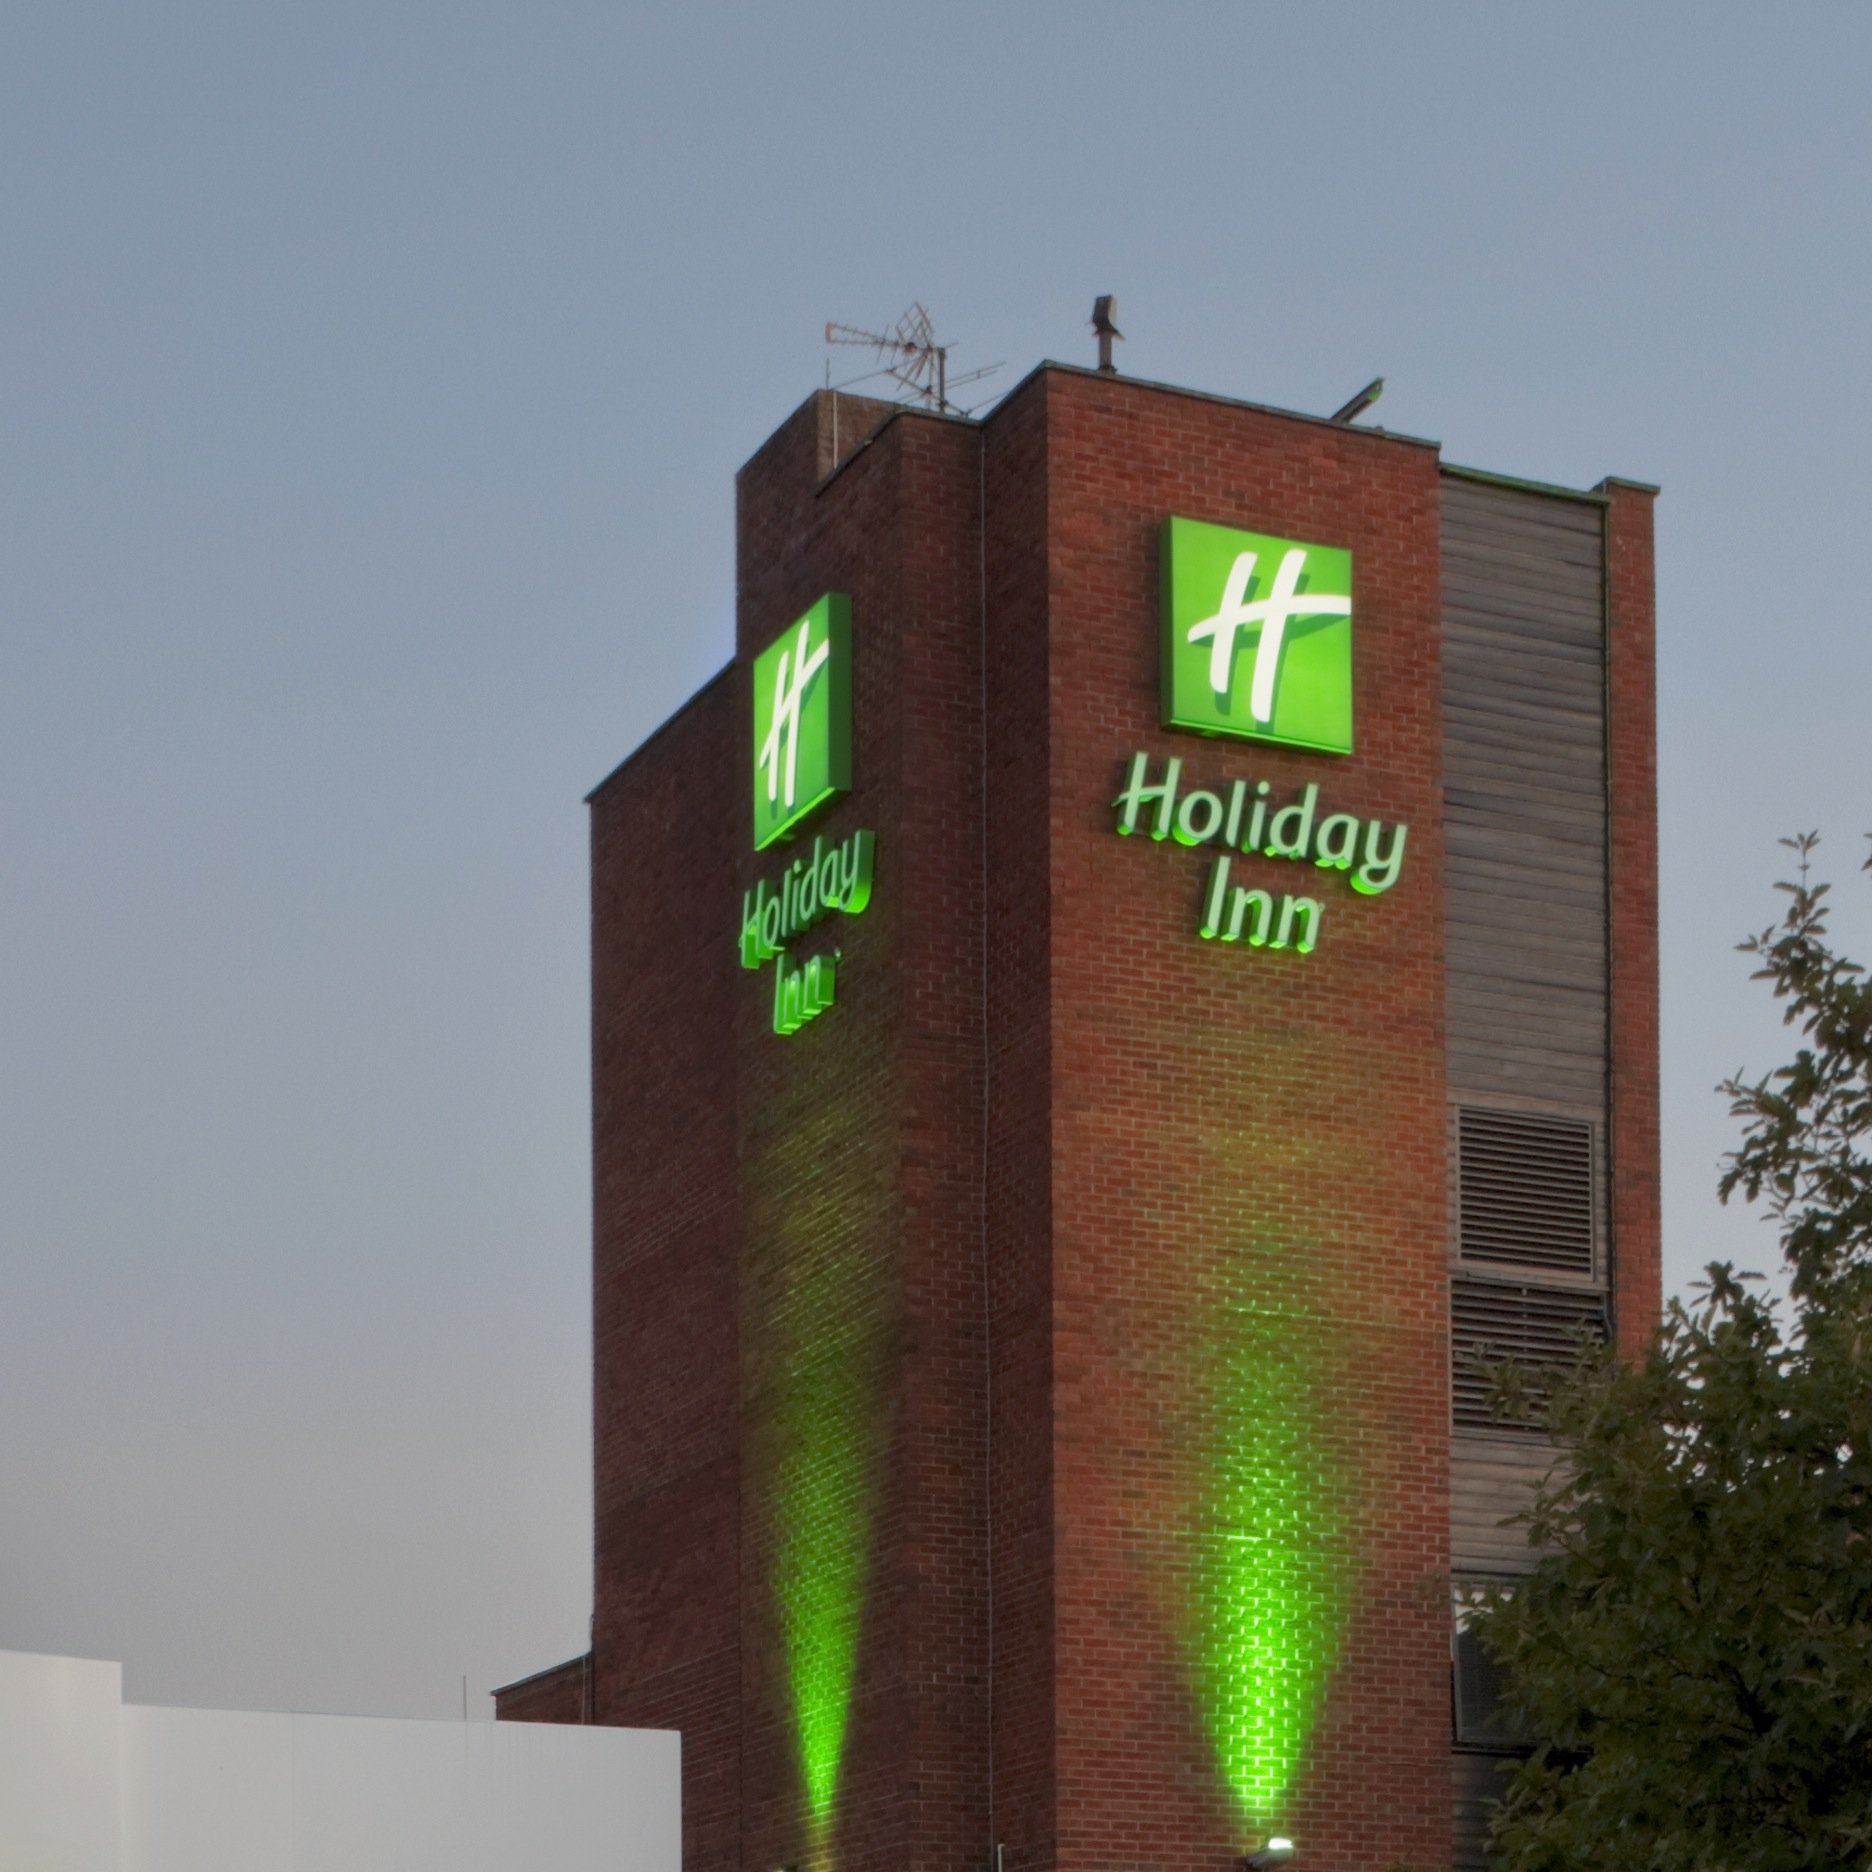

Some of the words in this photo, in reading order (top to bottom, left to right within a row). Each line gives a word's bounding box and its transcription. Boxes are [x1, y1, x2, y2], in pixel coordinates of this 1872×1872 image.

[1111, 751, 1408, 894] Holiday
[738, 829, 875, 969] Holiday
[1199, 855, 1323, 953] Inn
[773, 951, 836, 1034] Inn
